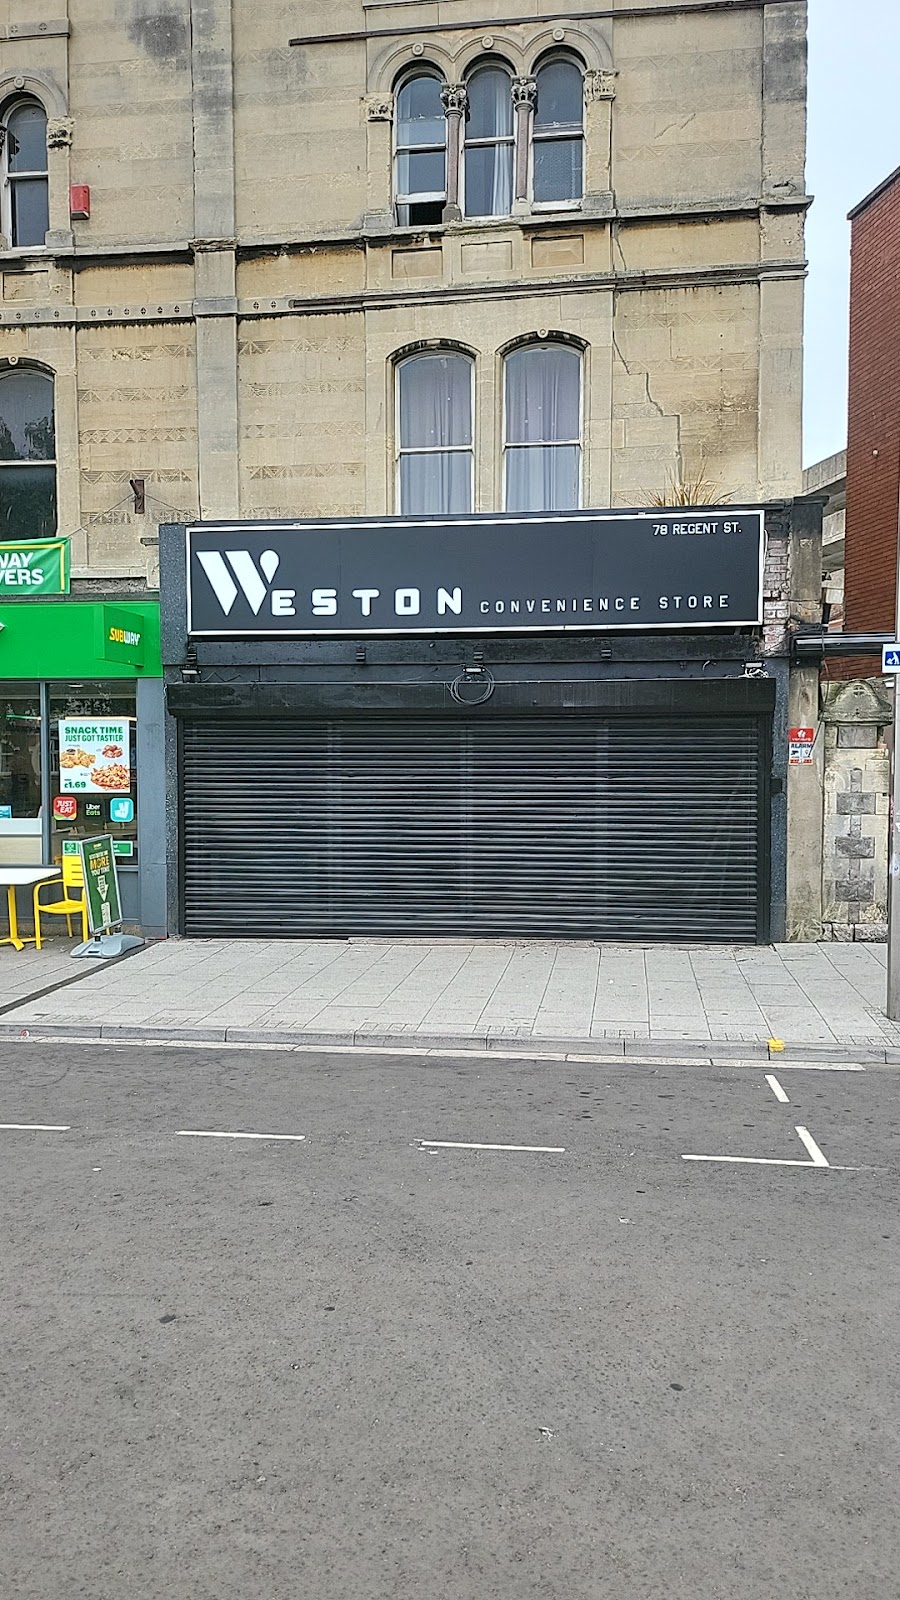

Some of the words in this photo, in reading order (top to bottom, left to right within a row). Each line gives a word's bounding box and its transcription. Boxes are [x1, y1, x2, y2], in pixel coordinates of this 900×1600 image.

[652, 524, 668, 536] 78
[672, 522, 718, 535] REGENT
[723, 521, 742, 534] ST.
[195, 549, 462, 617] WESTON
[479, 597, 641, 614] CONVENIENCE
[659, 594, 730, 609] STORE
[109, 627, 140, 646] SUBWAY
[64, 726, 98, 734] SNACK
[99, 726, 123, 734] TIME
[56, 800, 73, 808] JUST
[90, 855, 109, 870] MORE
